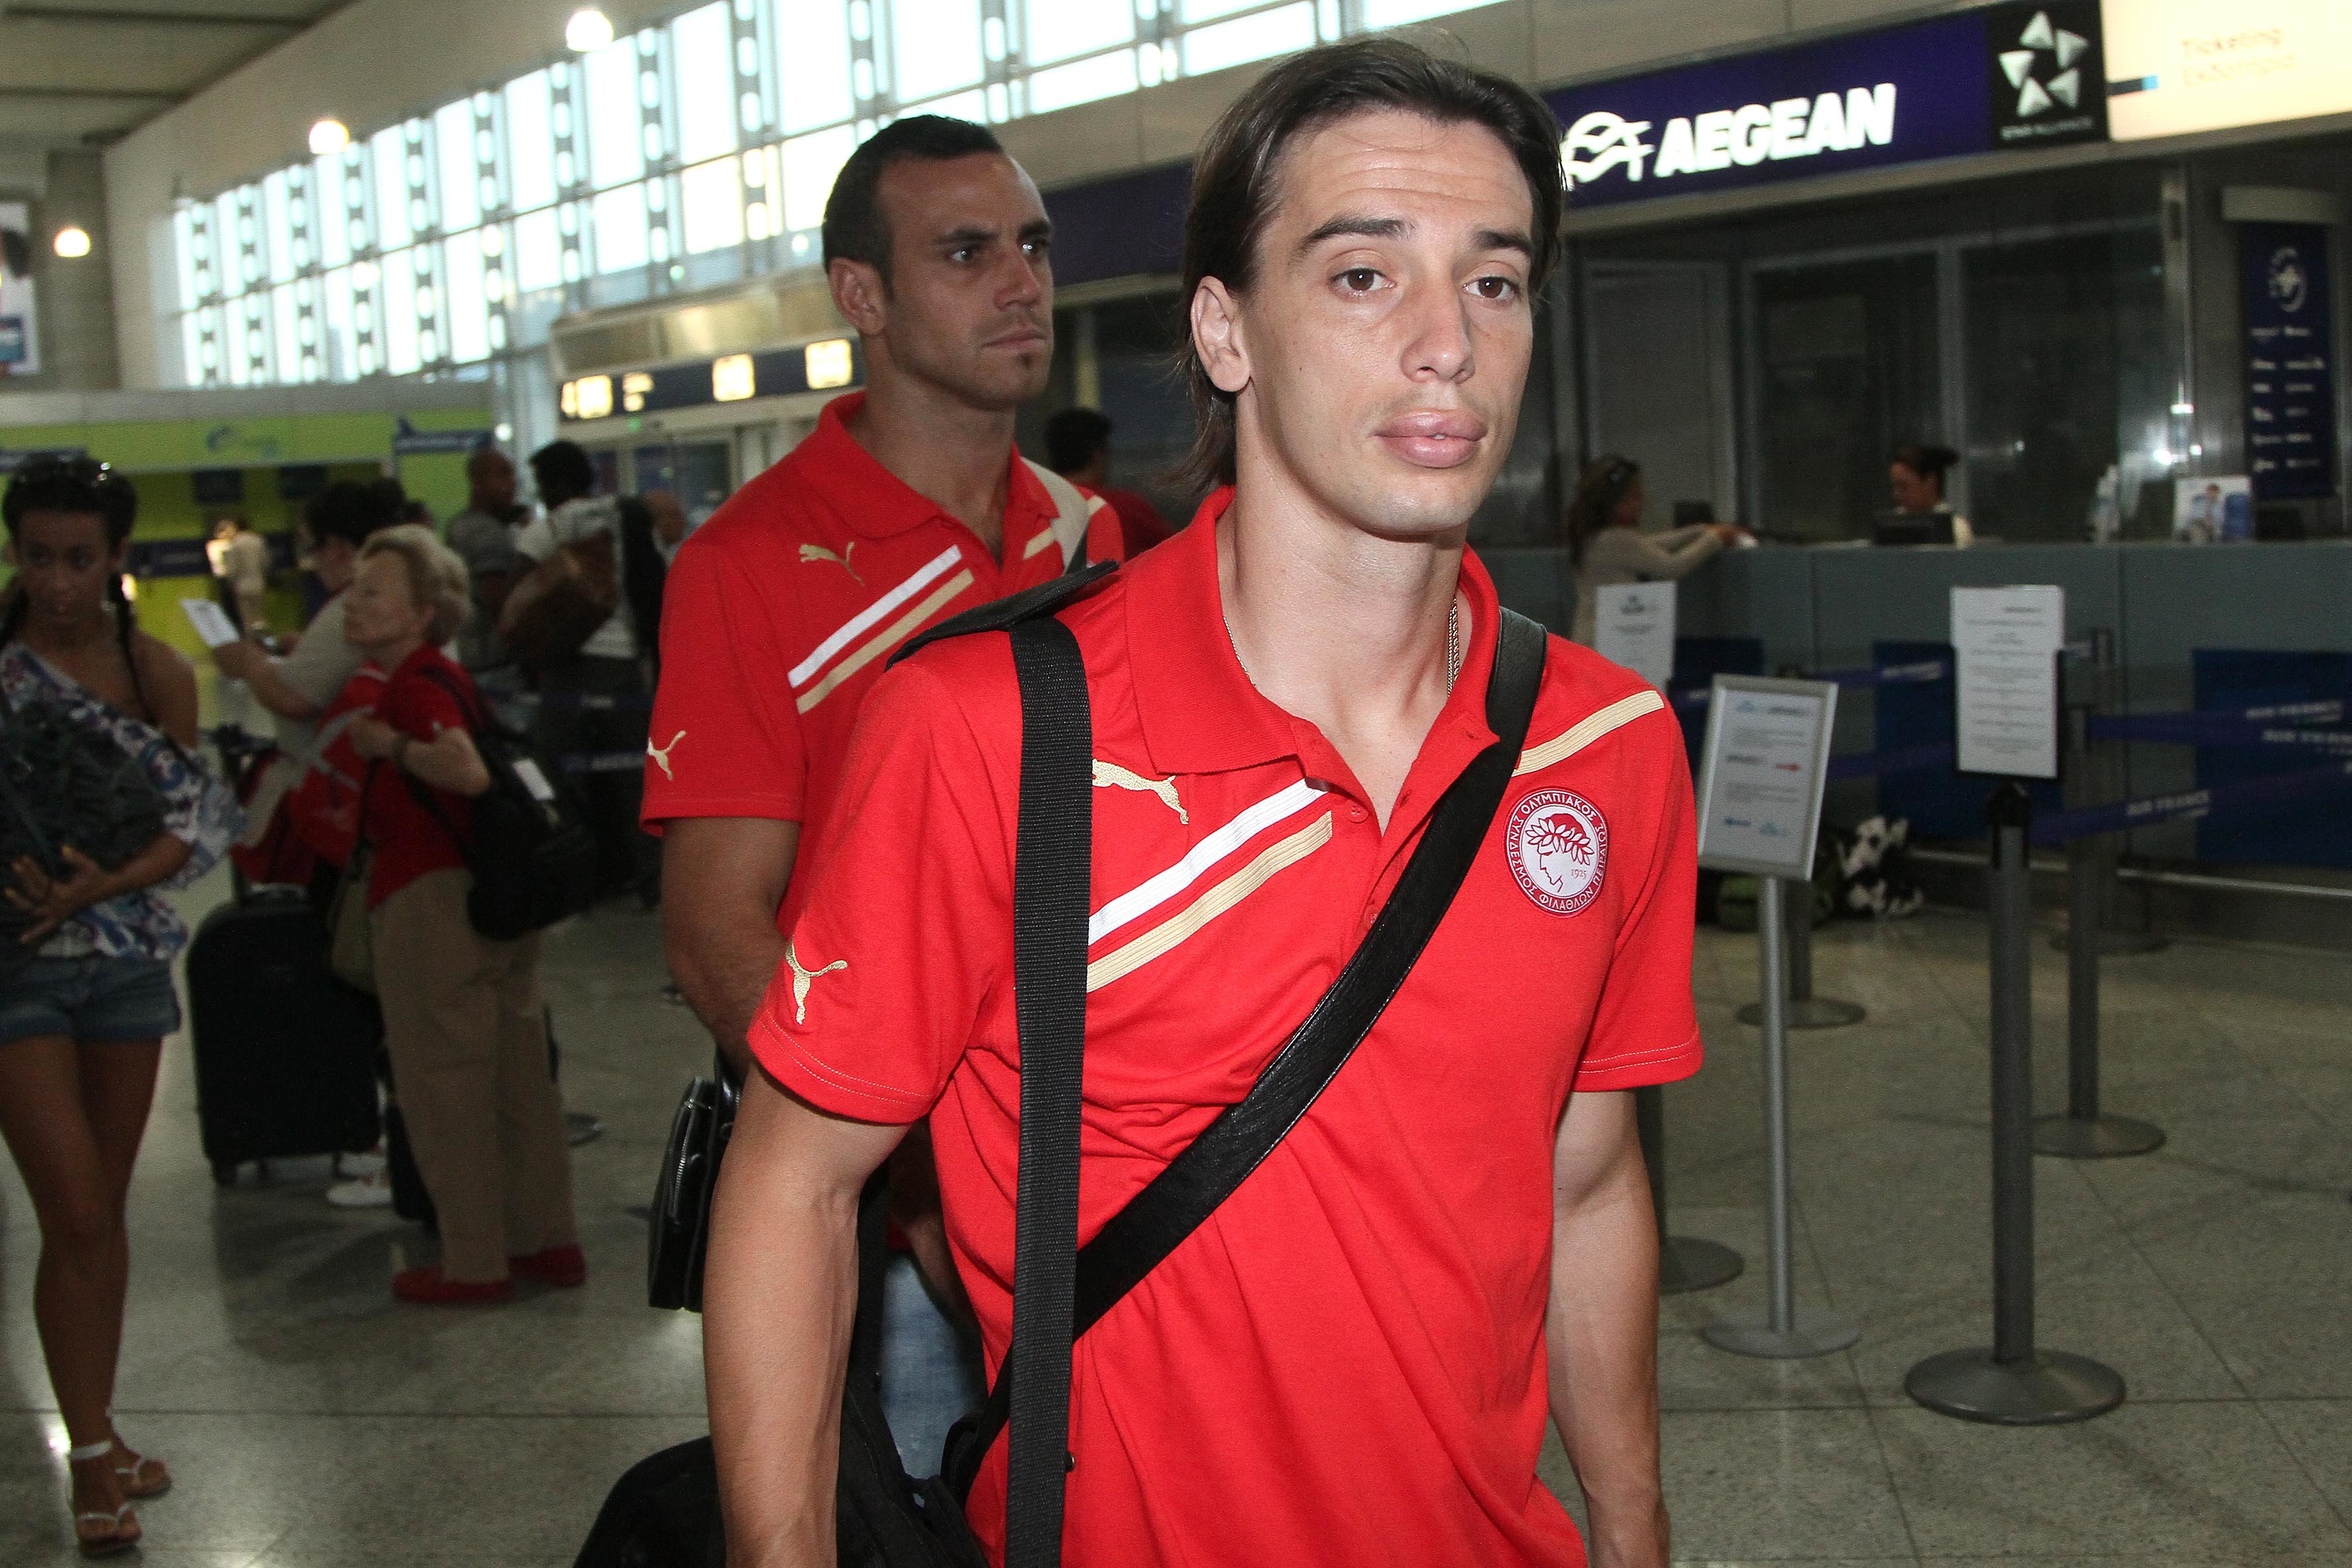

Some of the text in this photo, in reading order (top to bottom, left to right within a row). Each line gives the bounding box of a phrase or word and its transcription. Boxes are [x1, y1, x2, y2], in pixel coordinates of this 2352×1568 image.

[1654, 83, 1897, 177] AEGEAN
[1521, 793, 1597, 821] ΟΛΥΜΠΙΑΚΟΣ
[1509, 815, 1538, 896] ΣΥΝΔΕΣΜΟΣ
[1571, 869, 1587, 880] 1925
[1592, 823, 1608, 886] ΠΕΙΡΑΙΩΣ
[1539, 887, 1594, 911] ΦΙΛΑΘΛΩΝ
